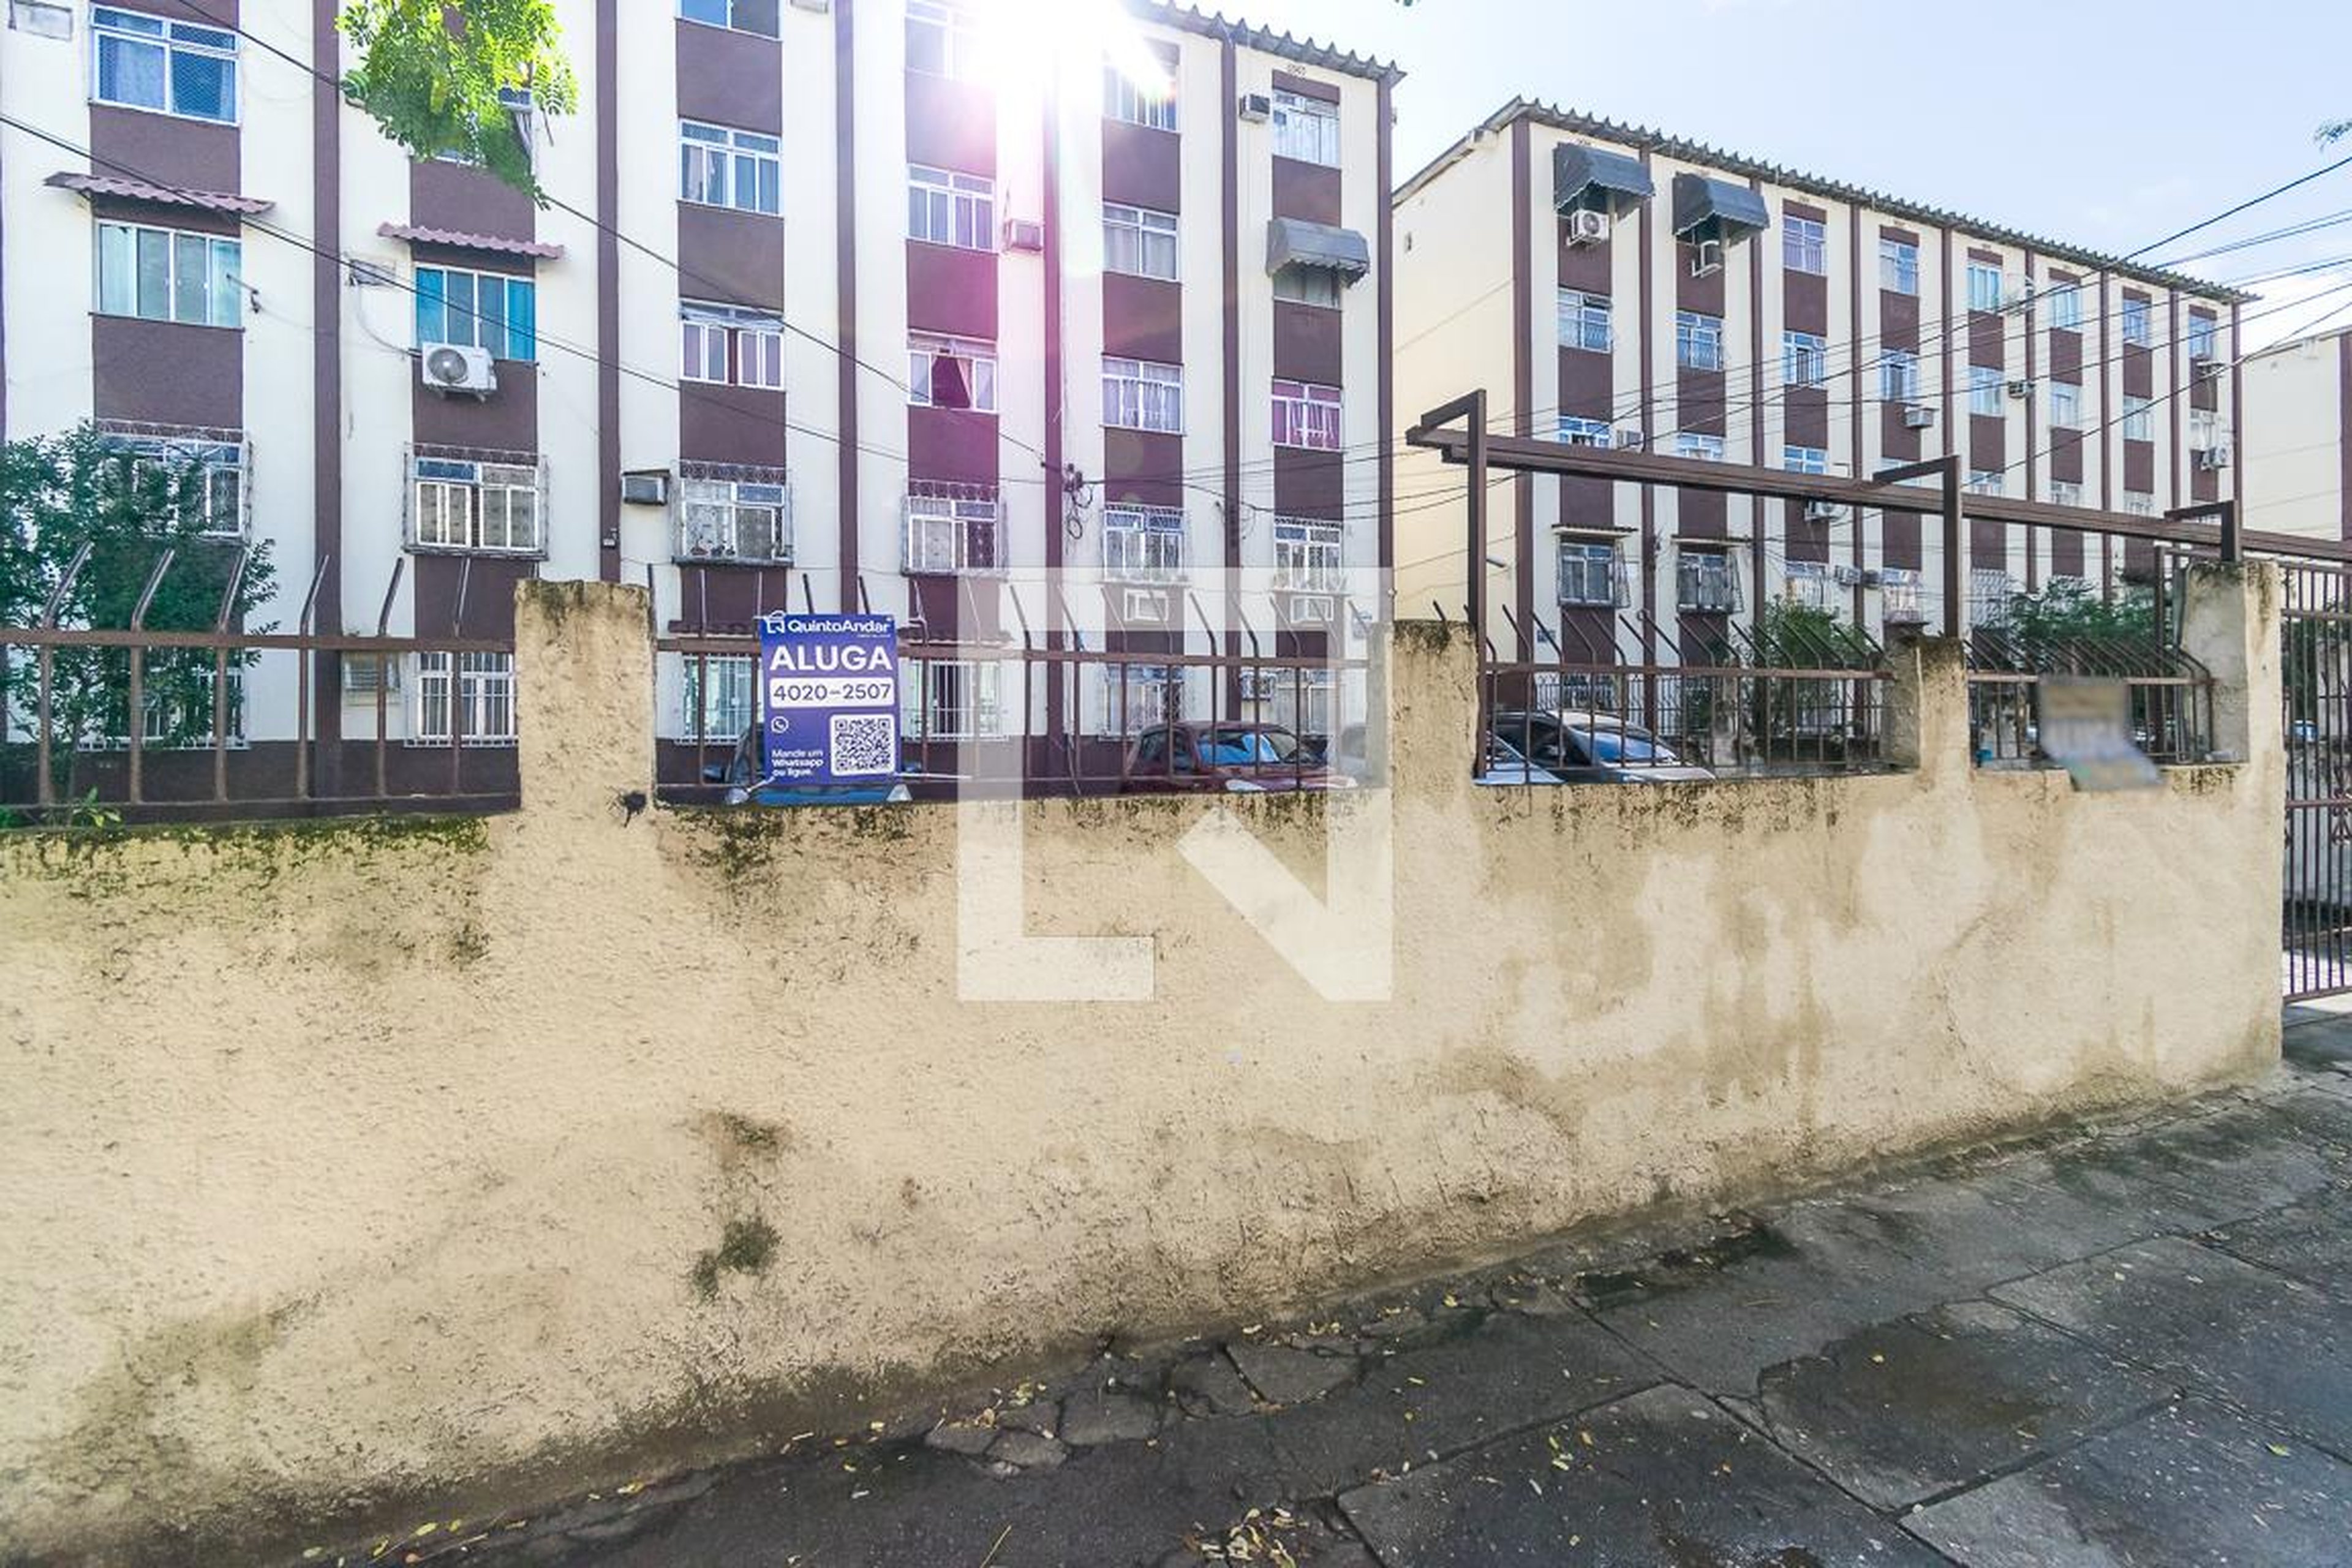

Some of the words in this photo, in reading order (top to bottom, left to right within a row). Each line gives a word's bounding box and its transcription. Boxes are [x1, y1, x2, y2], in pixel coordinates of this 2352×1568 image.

[788, 620, 890, 633] QuintoAndar
[770, 645, 893, 671] ALUGA
[774, 683, 891, 701] 4020-2507
[772, 749, 805, 758] Mande
